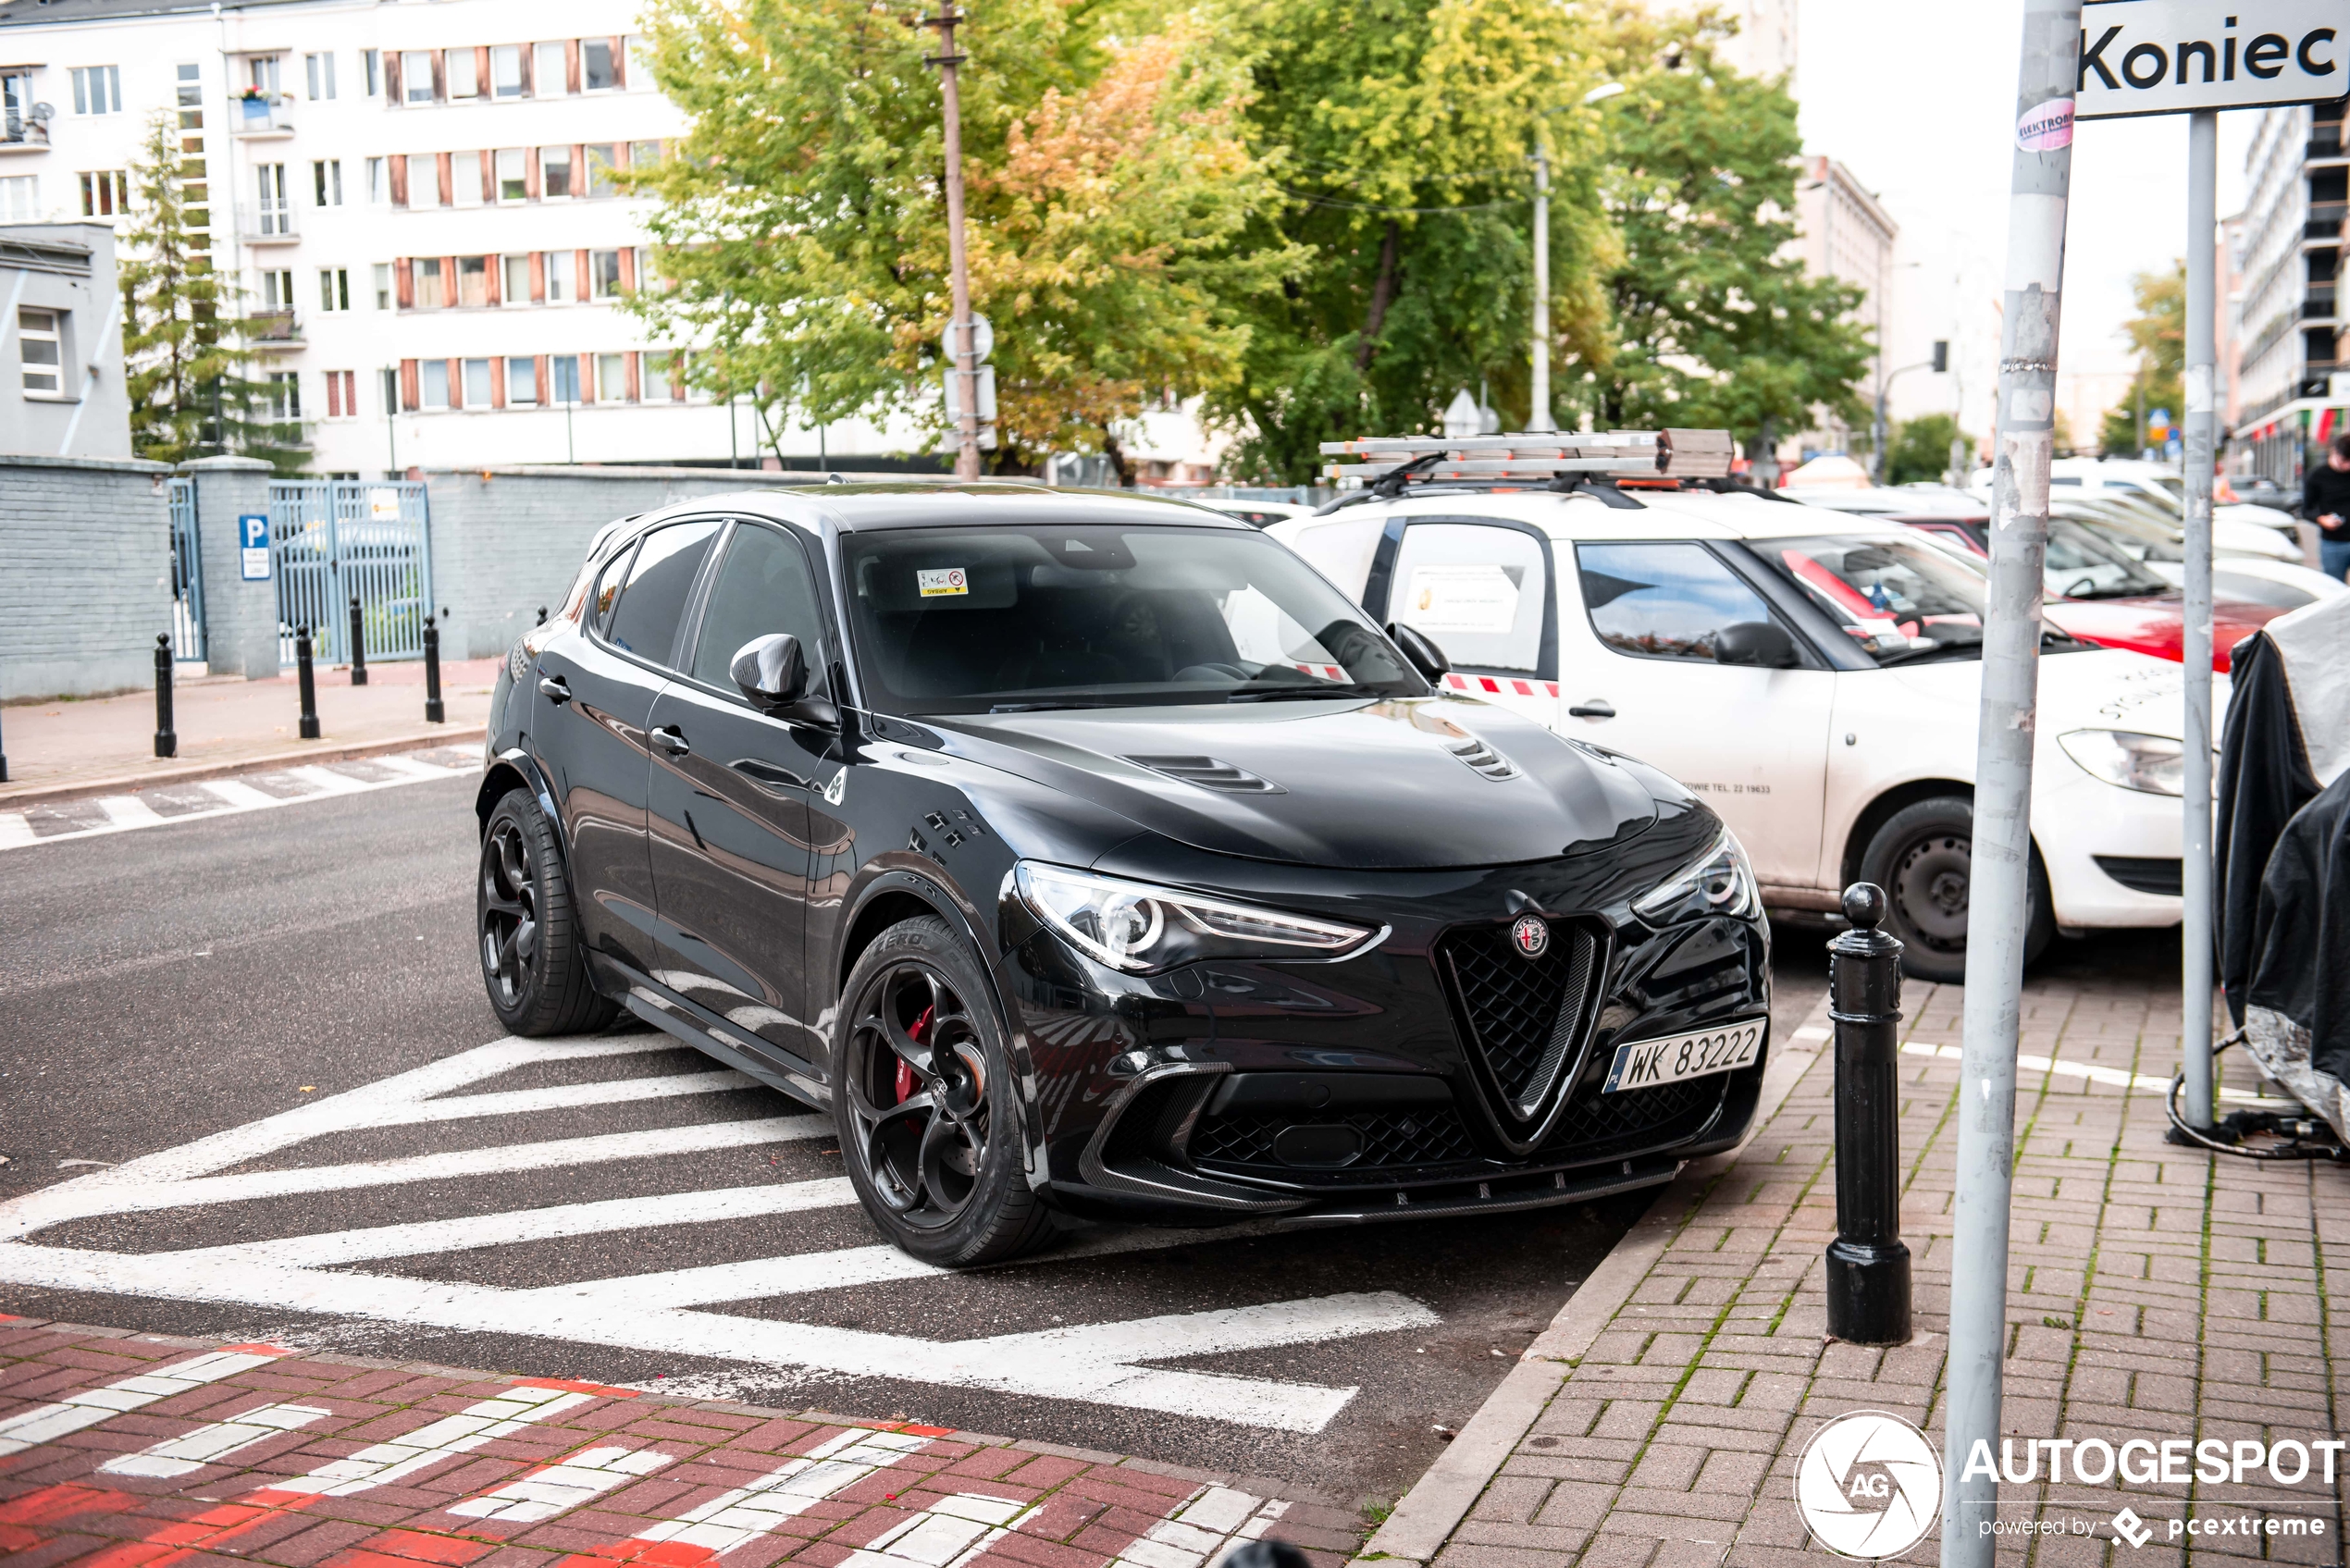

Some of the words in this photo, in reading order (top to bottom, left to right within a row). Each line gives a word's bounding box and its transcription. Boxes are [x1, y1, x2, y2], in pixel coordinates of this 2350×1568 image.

[2076, 15, 2338, 92] Koniec
[247, 518, 265, 547] P
[1734, 784, 1743, 793] 22
[1626, 1043, 1671, 1085] WK
[1674, 1027, 1757, 1076] 83222
[1609, 1074, 1619, 1085] PL
